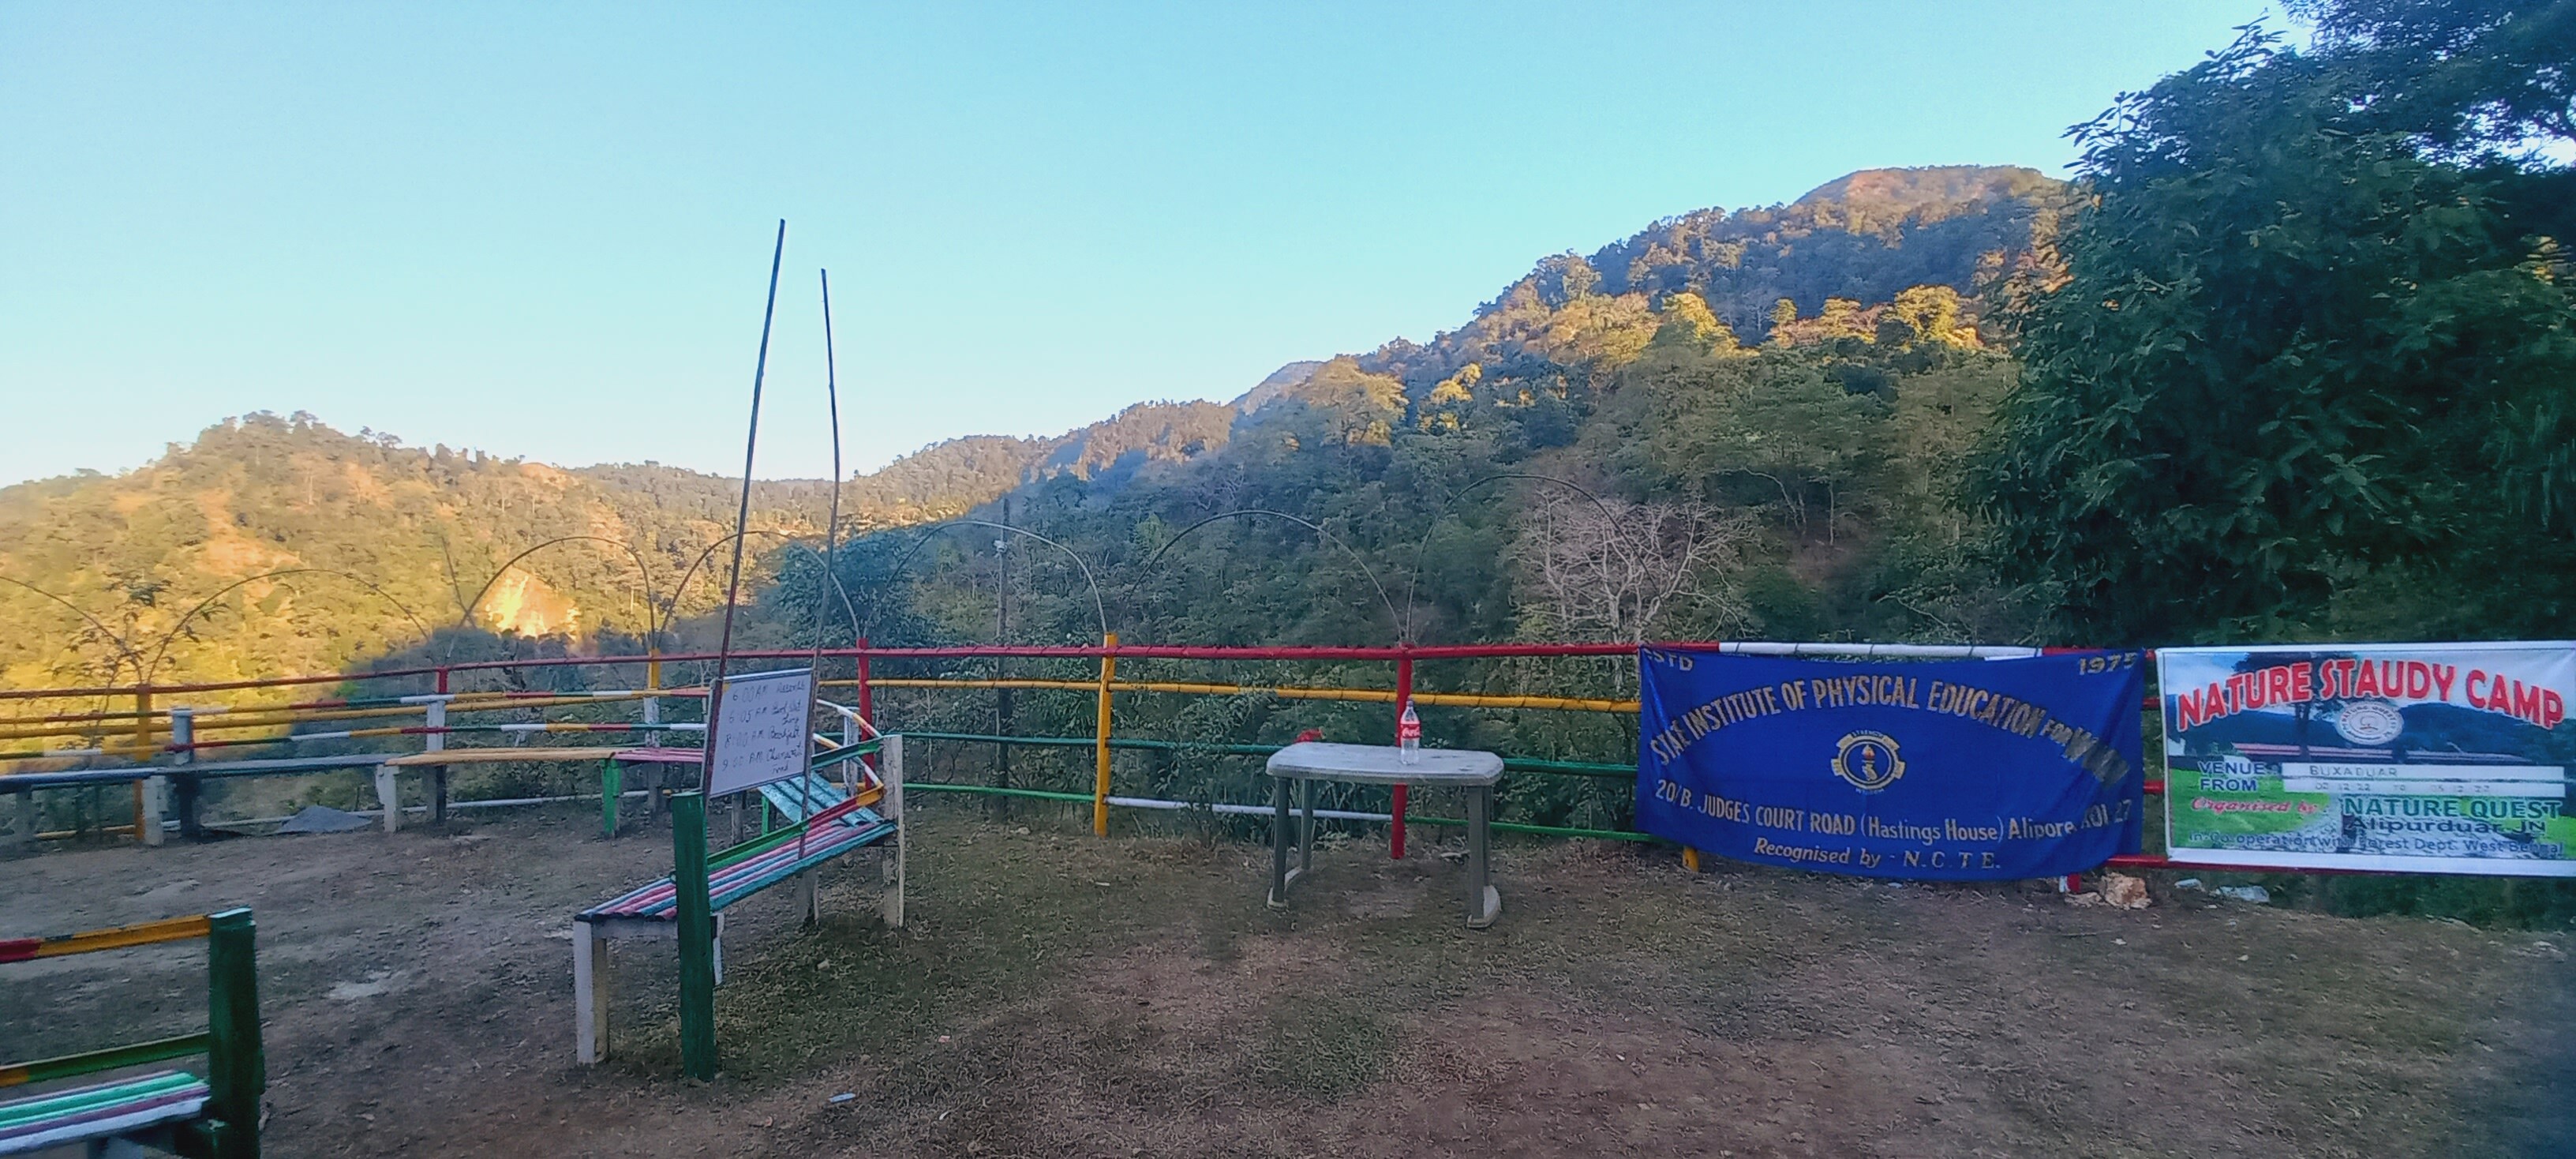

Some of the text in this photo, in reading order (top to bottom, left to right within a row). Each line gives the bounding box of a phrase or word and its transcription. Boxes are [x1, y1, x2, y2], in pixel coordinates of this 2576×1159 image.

[2079, 652, 2137, 676] 1975
[2178, 658, 2565, 731] NATURE STAUDY CAMP
[1682, 686, 1781, 741] INSTITUTE
[1780, 680, 1806, 711] OF
[1811, 675, 1919, 709] PHYSICAL
[1926, 681, 2046, 739] EDUCATION
[2200, 778, 2257, 792] FROM
[2191, 798, 2290, 813] Organised
[2345, 798, 2562, 820] NATURE QUEST
[1698, 794, 1750, 823] JUDGES
[1755, 805, 1805, 831] COURT
[1810, 812, 1855, 836] ROAD
[1860, 813, 1941, 846] (Hastings
[1945, 816, 2004, 843] House)
[2007, 816, 2077, 840] Alipore
[2512, 819, 2546, 834] JN
[1754, 837, 1851, 865] Recognised
[1859, 847, 1881, 869] by
[2463, 839, 2504, 853] West
